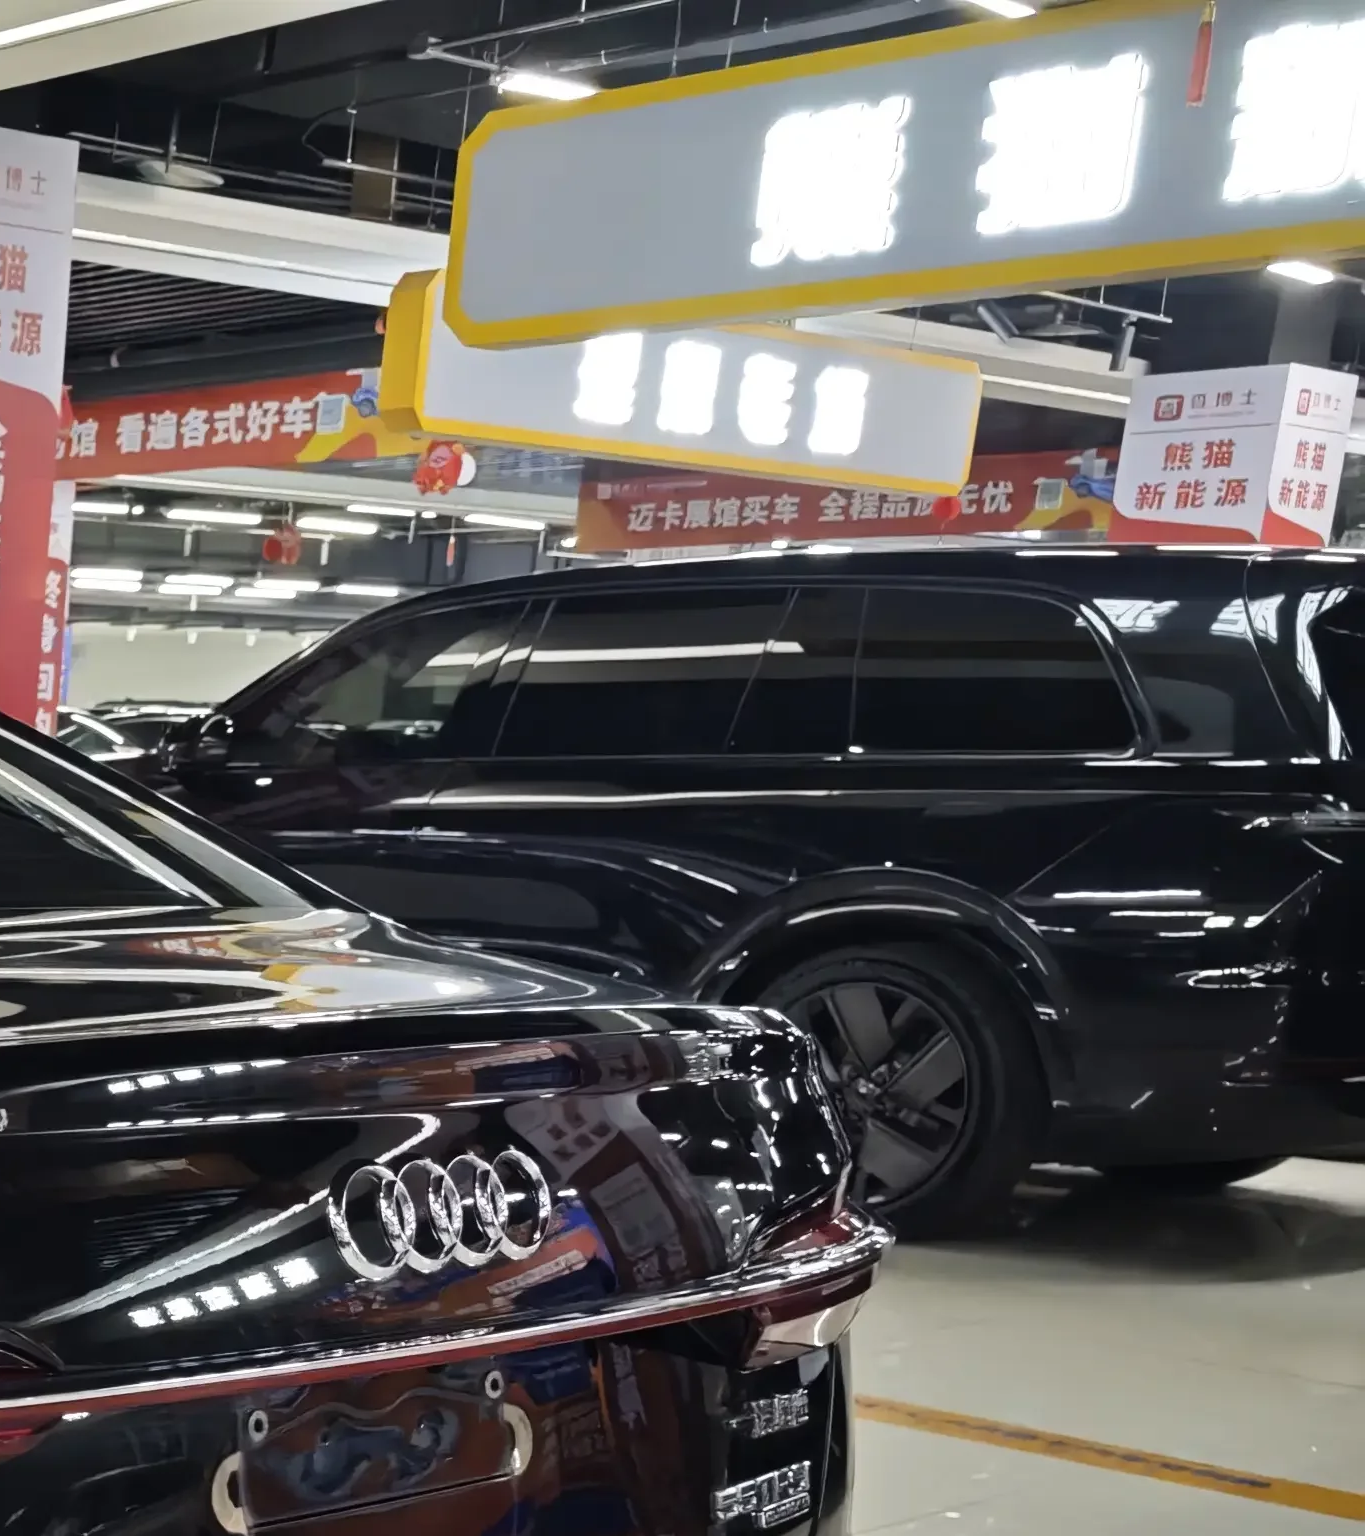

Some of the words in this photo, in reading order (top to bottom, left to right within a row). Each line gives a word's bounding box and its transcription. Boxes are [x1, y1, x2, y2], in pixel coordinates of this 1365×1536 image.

[115, 395, 317, 455] 看遍各式好车
[1161, 438, 1237, 471] 熊猫
[1293, 439, 1327, 472] 熊猫
[1134, 477, 1249, 511] 新能源
[1278, 478, 1329, 512] 新能源
